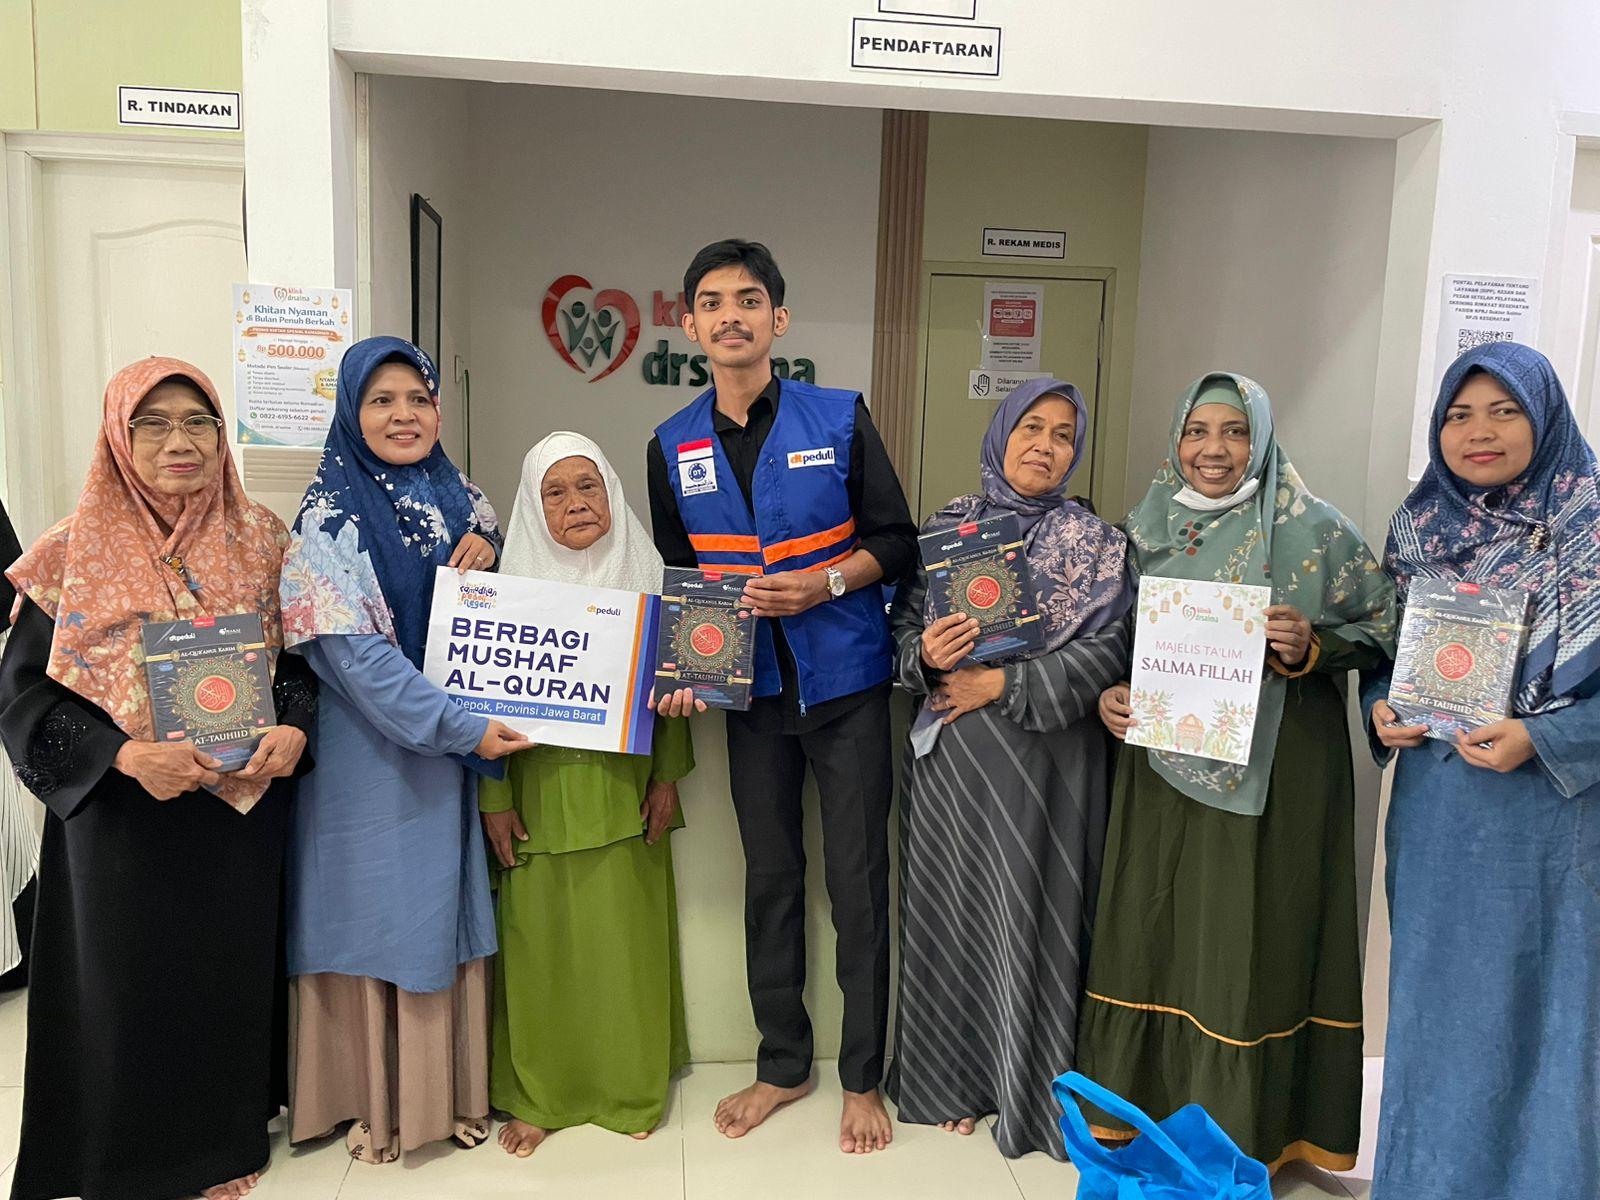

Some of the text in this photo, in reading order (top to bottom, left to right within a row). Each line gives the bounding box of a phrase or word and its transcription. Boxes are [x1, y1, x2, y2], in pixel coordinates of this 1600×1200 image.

[860, 37, 992, 57] PENDAFTARAN
[127, 100, 231, 116] R. TINDAKAN
[999, 239, 1031, 247] REKAM
[1032, 240, 1060, 249] MEDIS
[254, 305, 328, 317] Khitan Nyaman
[255, 315, 277, 323] Bulan
[279, 317, 304, 325] Penuh
[305, 318, 335, 326] Berkah
[257, 344, 324, 358] Rp 500.000
[586, 603, 621, 616] dtpeduli
[450, 617, 590, 651] BERBAGI
[1155, 640, 1242, 659] MAJELIS TA'LIM
[447, 642, 578, 674] MUSHAF
[681, 674, 726, 683] AT-TAUHIID
[1141, 657, 1253, 684] SALMA FILLAH
[444, 669, 611, 704] AL-QURAN
[455, 698, 601, 722] Depok, Provinsi Jawa Barat
[1418, 697, 1473, 714] AT-TAUHIID
[194, 730, 248, 745] AT-TAUHIID
